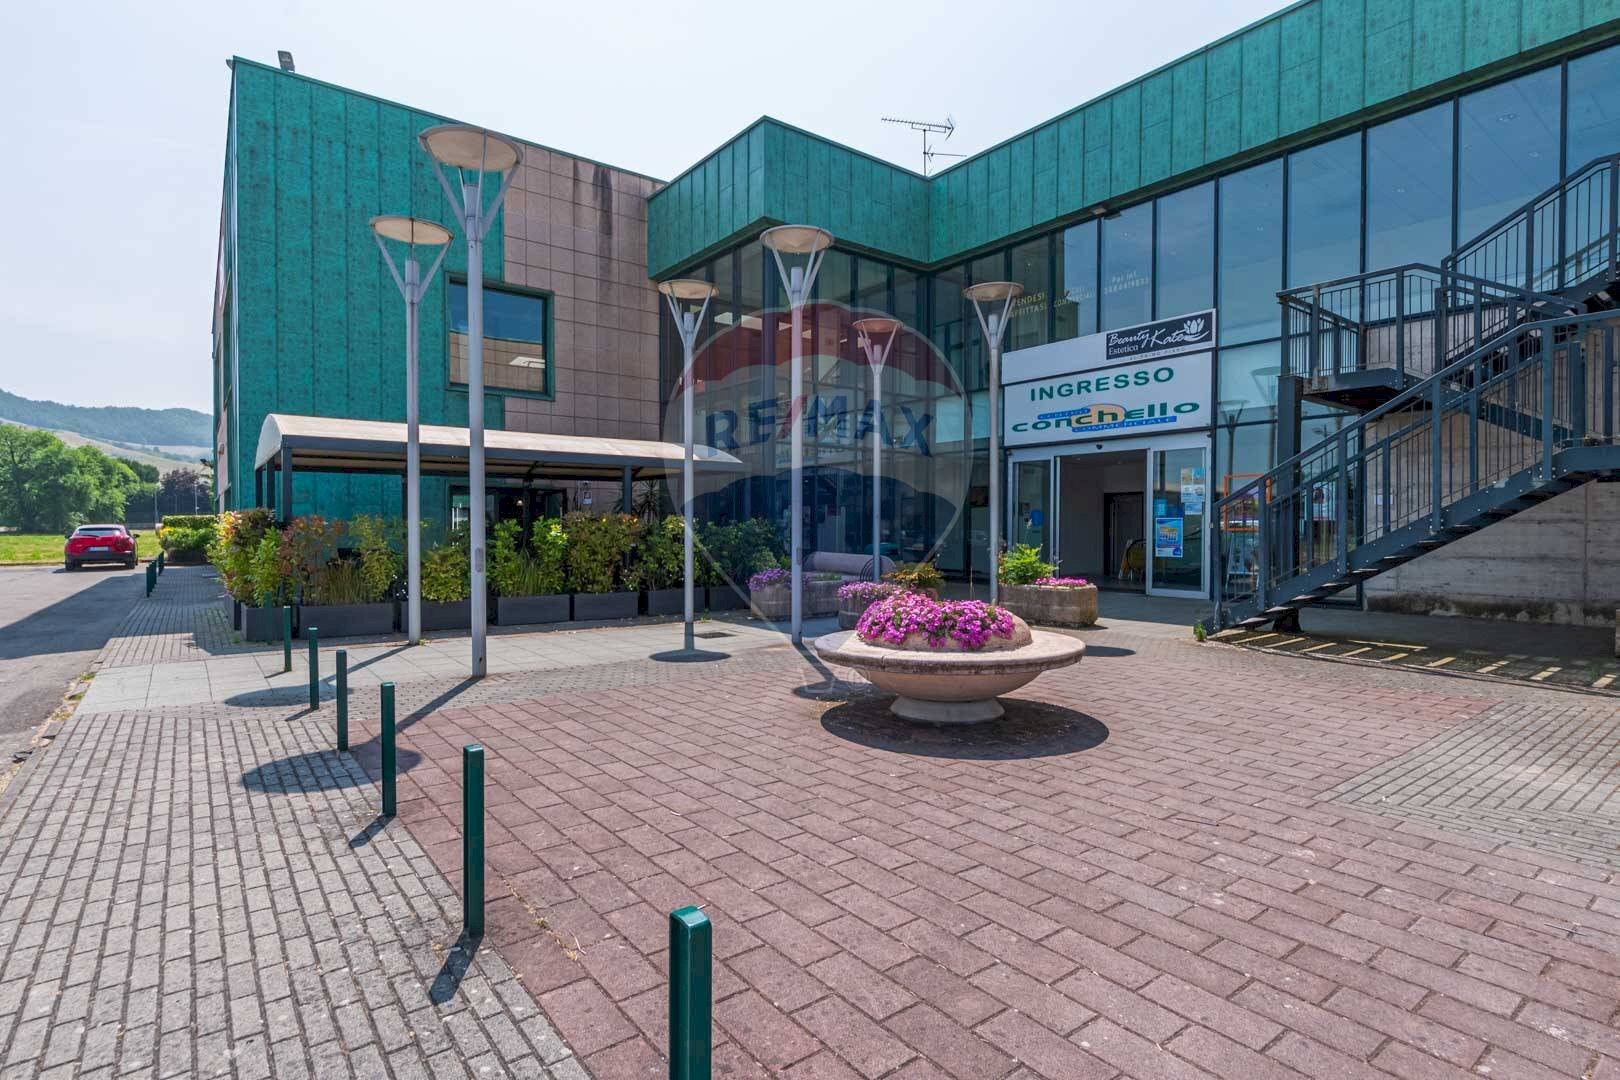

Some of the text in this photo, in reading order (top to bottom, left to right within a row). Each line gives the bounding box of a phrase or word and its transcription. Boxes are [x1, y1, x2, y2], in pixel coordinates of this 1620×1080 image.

[1108, 328, 1186, 348] Beauty Kate
[1109, 344, 1139, 356] Estetica
[1030, 367, 1174, 401] INGRESSO
[1012, 402, 1200, 432] conchello
